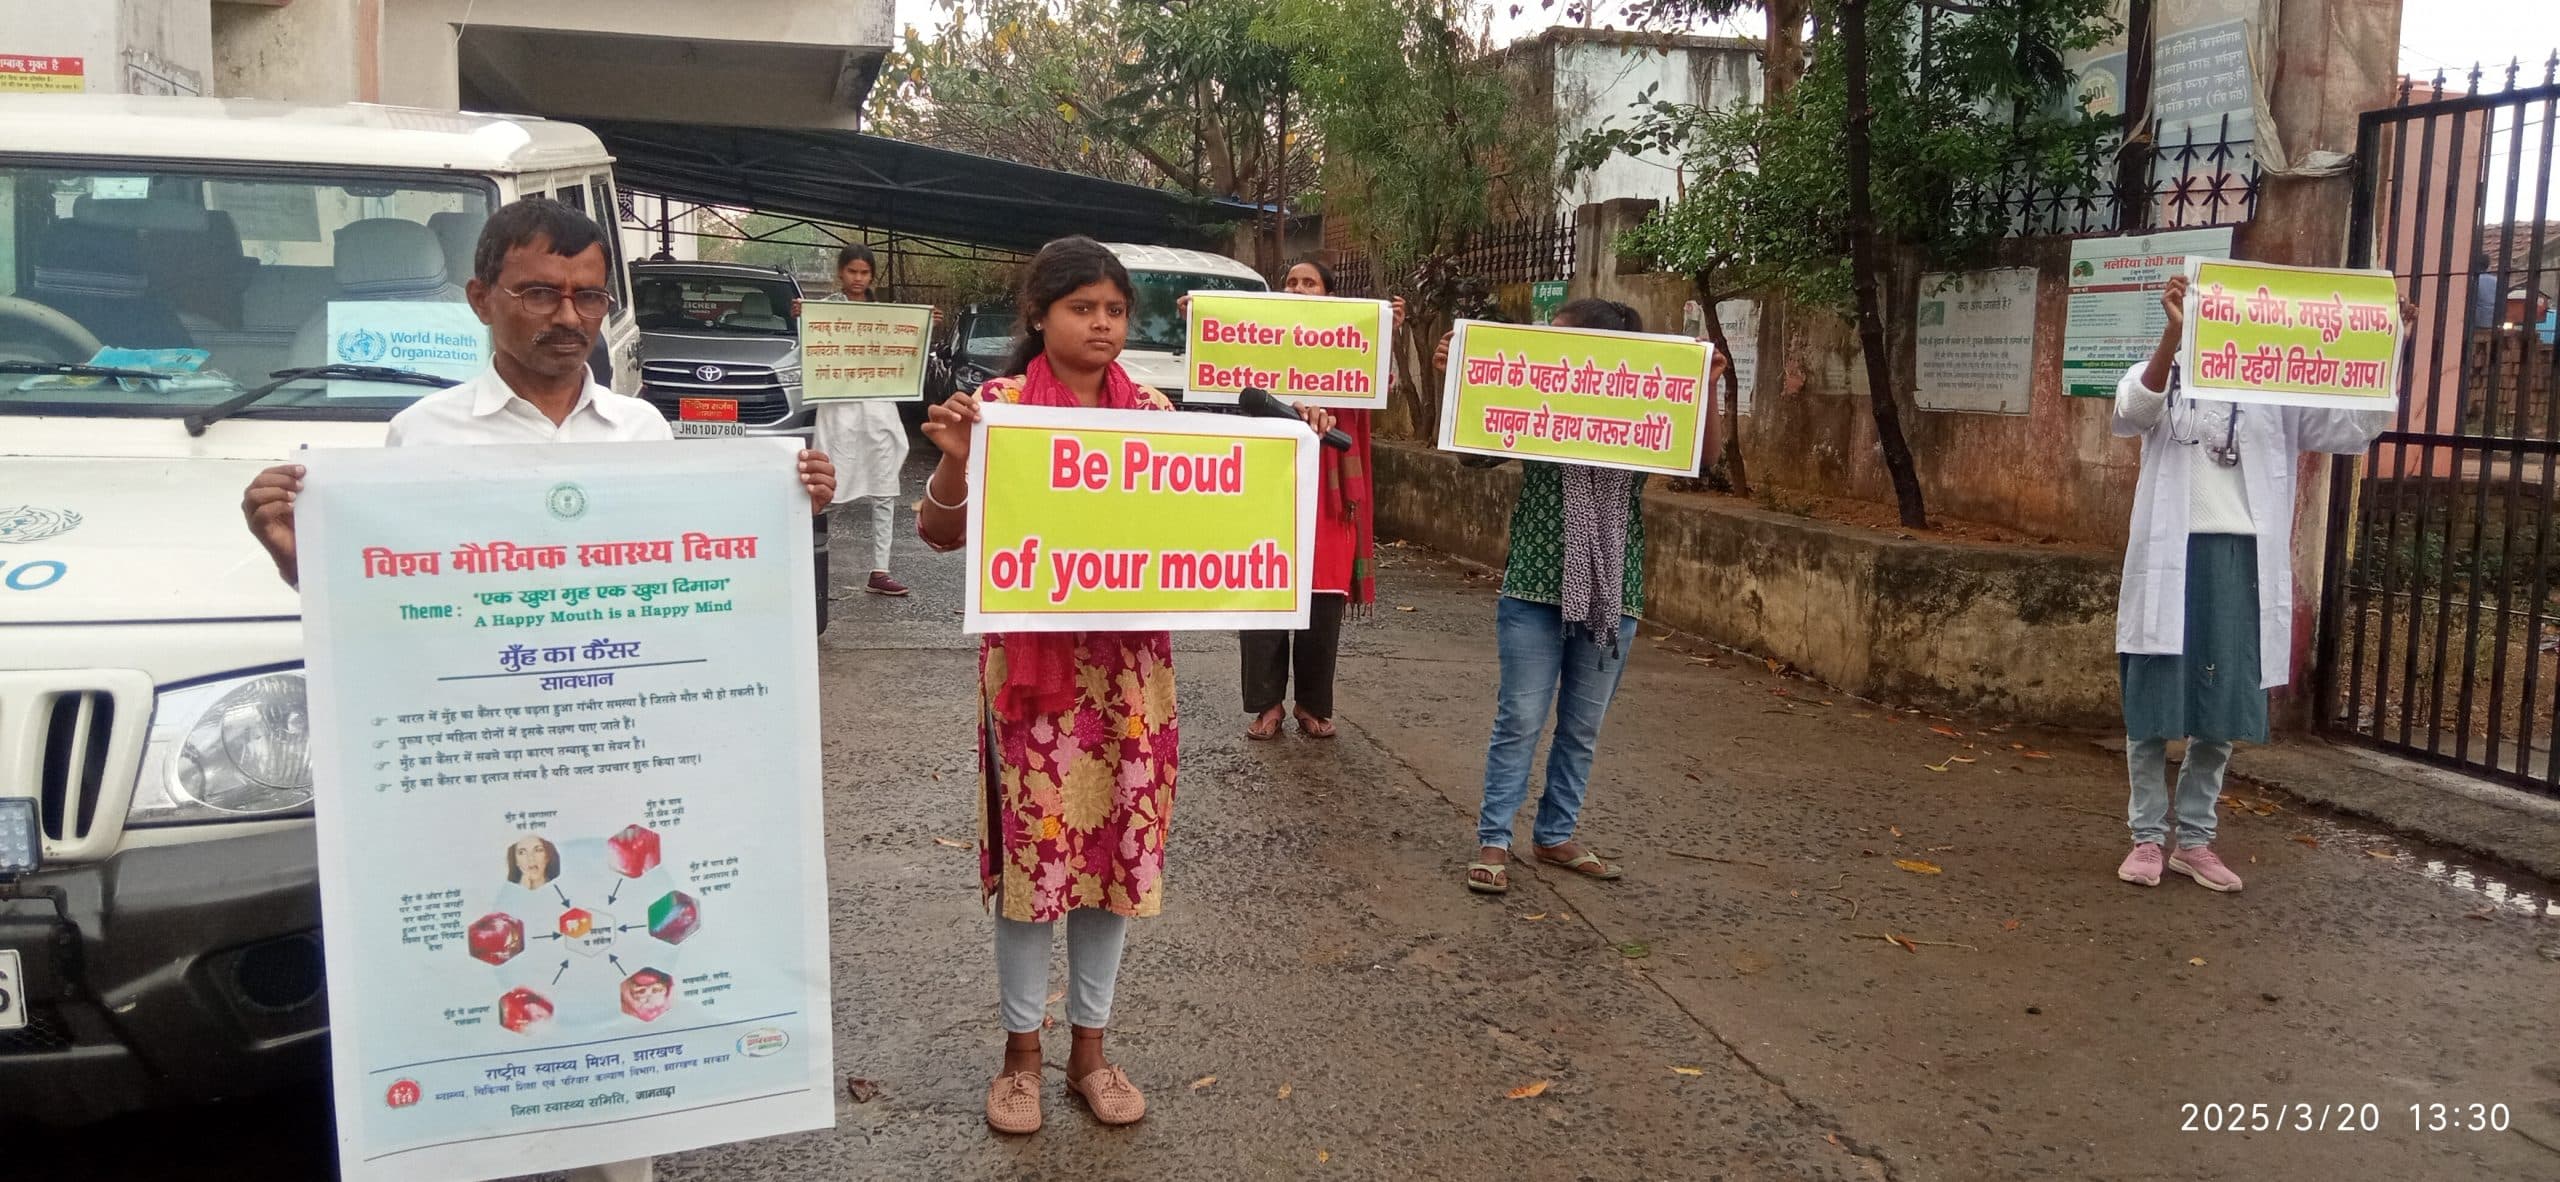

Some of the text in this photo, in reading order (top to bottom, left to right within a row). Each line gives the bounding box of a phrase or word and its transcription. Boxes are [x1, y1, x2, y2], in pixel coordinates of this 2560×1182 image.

[2201, 284, 2241, 325] दाँत,
[2247, 287, 2293, 328] जीभ,
[2298, 292, 2343, 343] मसूड़े
[2348, 305, 2393, 336] साफ,
[391, 331, 477, 347] World Health
[1202, 320, 1369, 353] Better tooth,
[391, 347, 477, 361] Organization
[2201, 341, 2386, 389] तभी रहेंगे निरोग आप।
[1198, 364, 1369, 393] Better health
[1468, 352, 1696, 404] खाने के पहले और शौच के बाद
[1485, 407, 1529, 449] साबुन
[1533, 404, 1550, 437] से
[1552, 415, 1583, 442] हाथ
[1586, 417, 1631, 447] जरूर
[1052, 439, 1242, 493] Be Proud
[363, 533, 759, 578] विश्व मौखिक स्वास्थ्य दिवस
[990, 538, 1289, 602] of your mouth
[518, 589, 556, 608] खुश
[597, 584, 627, 599] एक
[632, 582, 668, 601] खुश
[474, 600, 733, 628] A Happy Mouth is a Happy Mind
[499, 638, 642, 672] मुँह का कैंसर
[540, 672, 615, 692] सावधान
[398, 713, 424, 724] भारत
[429, 710, 438, 720] में
[461, 710, 474, 720] का
[504, 707, 521, 718] एक
[553, 702, 572, 717] हुआ
[702, 688, 714, 700] भी
[717, 687, 726, 700] हो
[578, 722, 598, 734] पाए
[601, 718, 620, 731] जाते
[526, 747, 554, 758] कारण
[552, 764, 570, 777] यदि
[652, 755, 675, 767] किया
[485, 1063, 527, 1081] राष्ट्रीय
[634, 1044, 684, 1062] झारखण्ड
[511, 1103, 540, 1117] जिला
